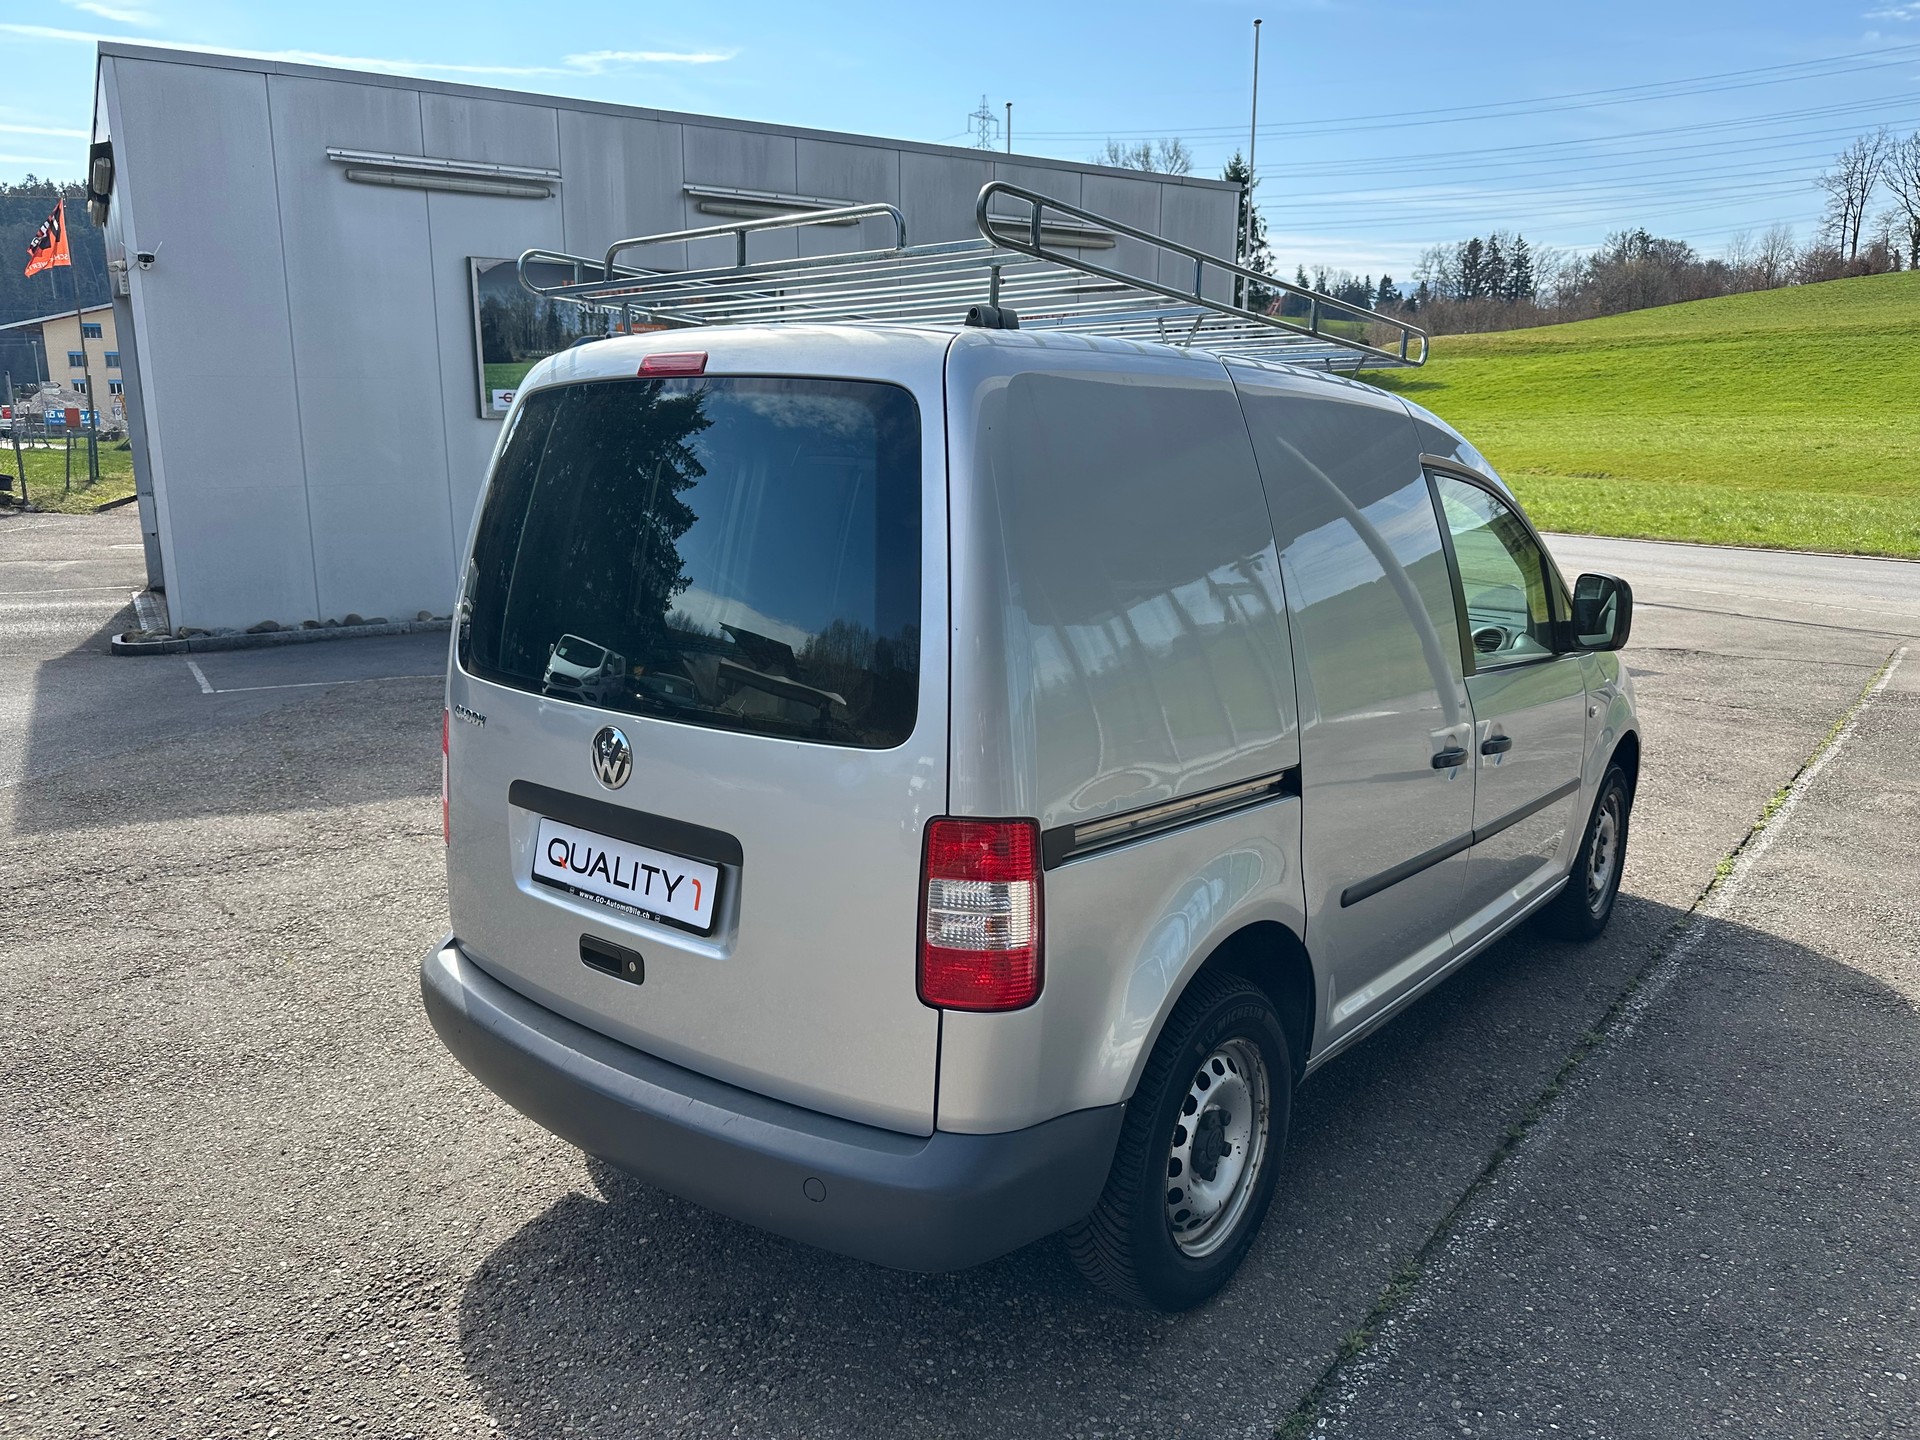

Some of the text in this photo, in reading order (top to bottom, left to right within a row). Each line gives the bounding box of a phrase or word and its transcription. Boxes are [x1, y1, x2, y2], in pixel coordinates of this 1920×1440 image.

[547, 837, 702, 911] QUALITY 1
[1215, 1005, 1265, 1033] MICHELIN
